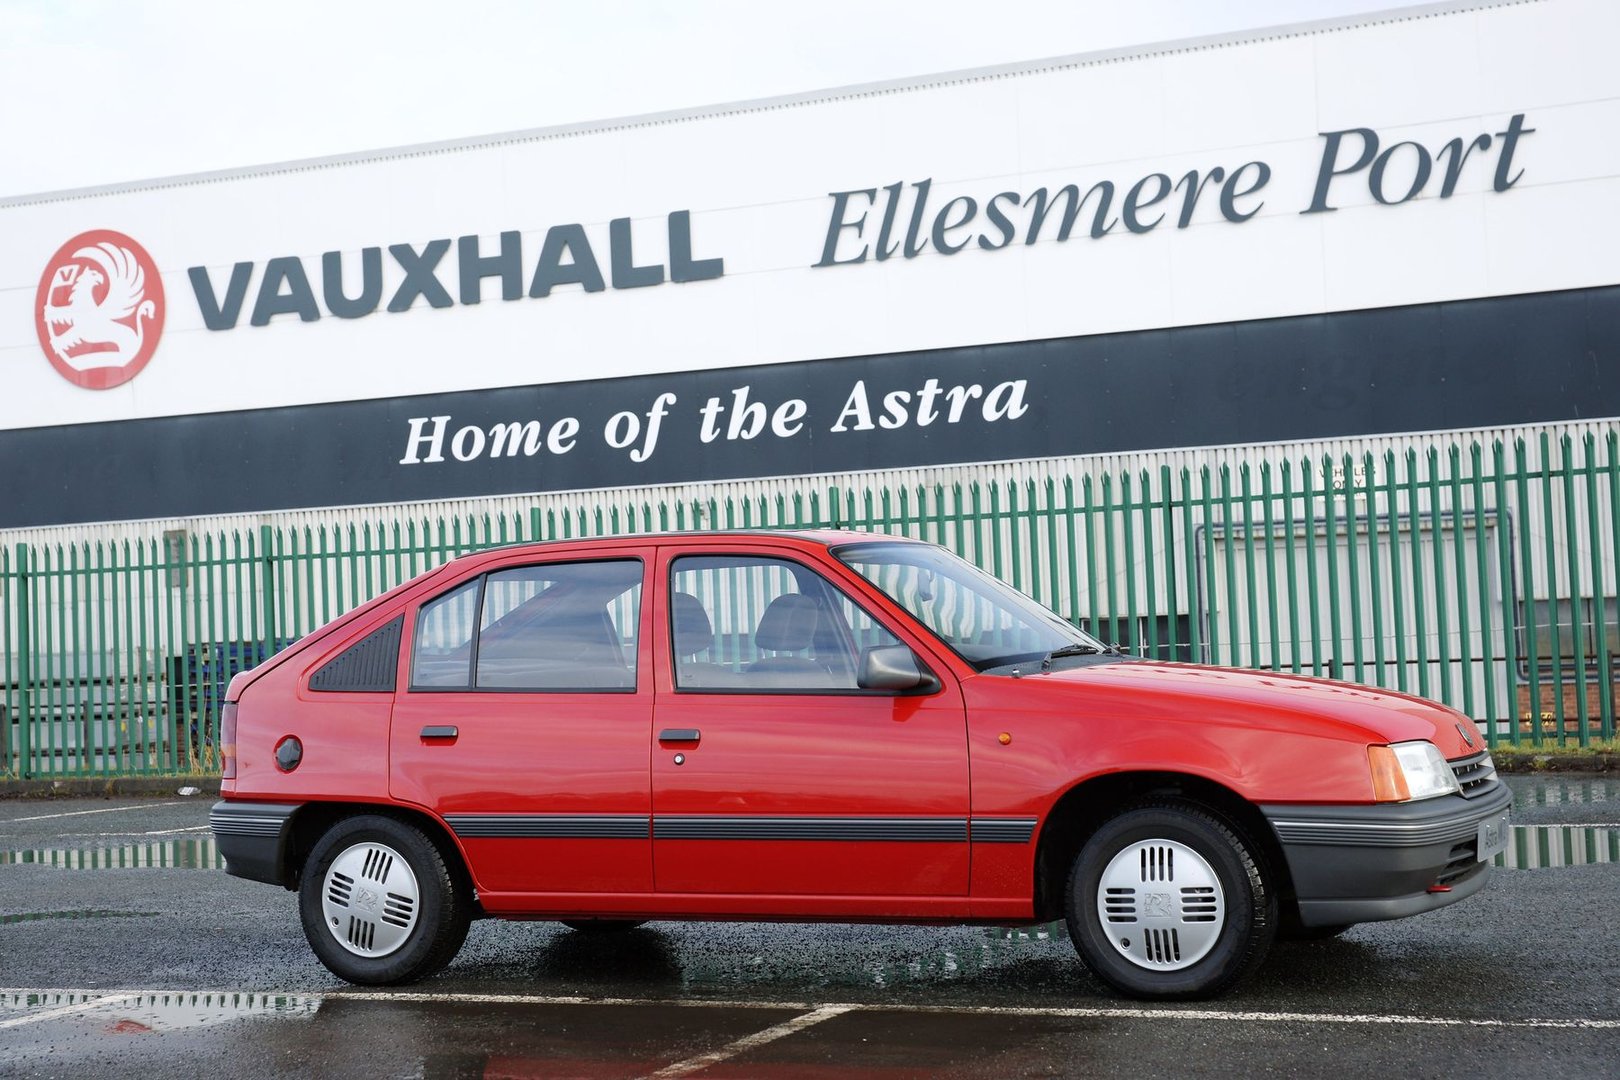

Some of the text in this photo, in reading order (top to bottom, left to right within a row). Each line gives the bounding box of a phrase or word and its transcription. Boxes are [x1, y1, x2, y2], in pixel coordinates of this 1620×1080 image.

[810, 113, 1536, 270] Ellesmere Port
[187, 209, 725, 332] VAUXHALL
[399, 378, 1029, 466] Home of the Astra
